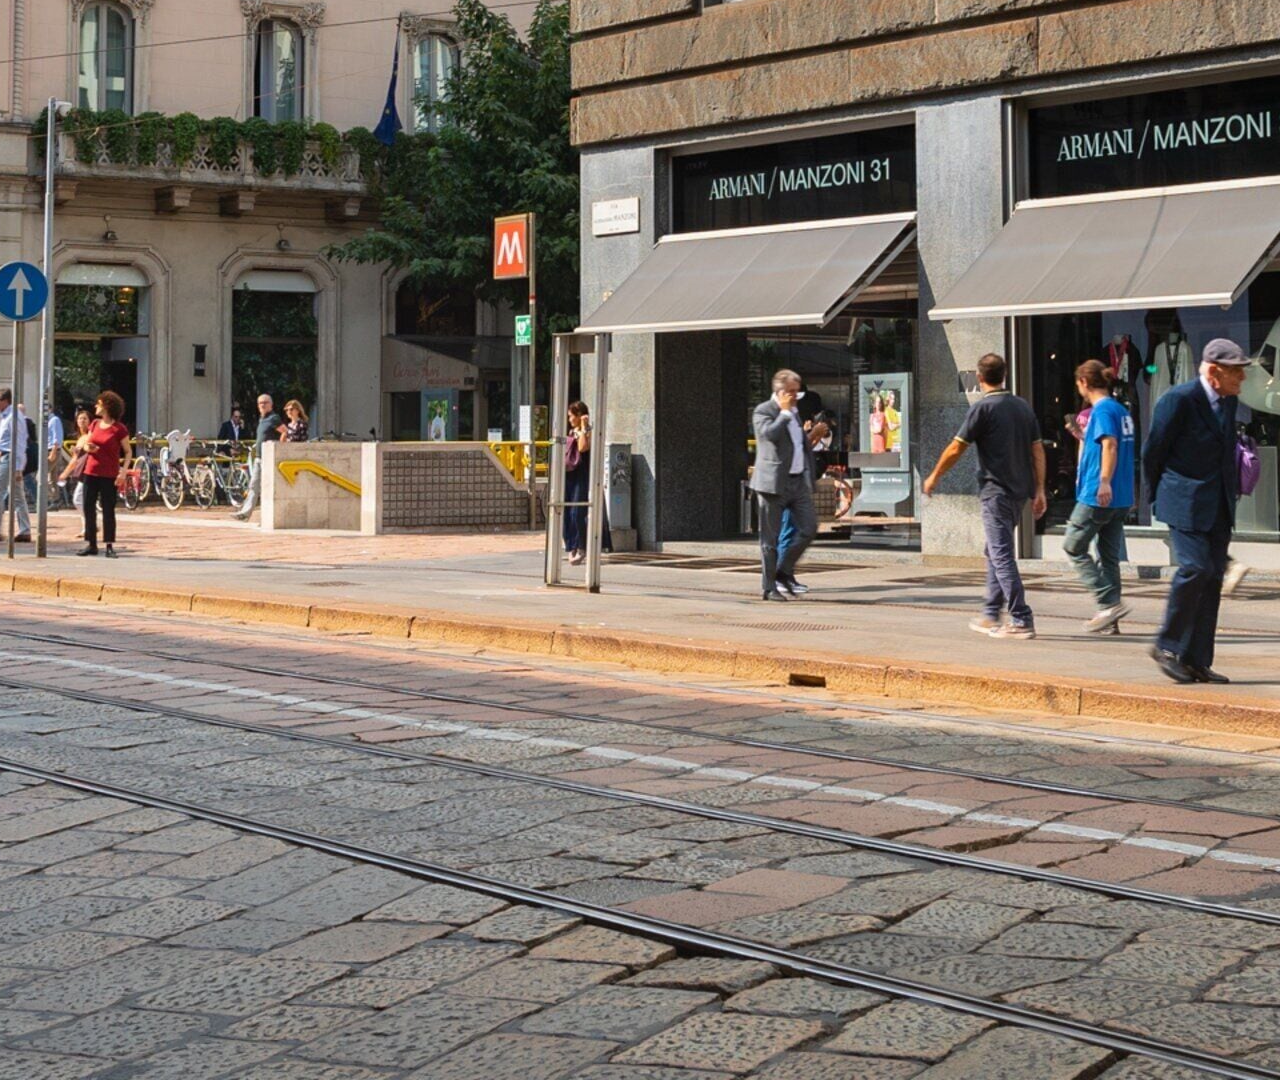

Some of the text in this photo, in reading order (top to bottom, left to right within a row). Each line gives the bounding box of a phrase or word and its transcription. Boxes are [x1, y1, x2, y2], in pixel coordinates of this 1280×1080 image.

[1056, 128, 1134, 162] ARMANI
[1153, 111, 1271, 150] MANZONI
[708, 172, 766, 201] ARMANI
[779, 160, 865, 192] MANZONI
[870, 158, 890, 182] 31
[496, 230, 524, 266] M
